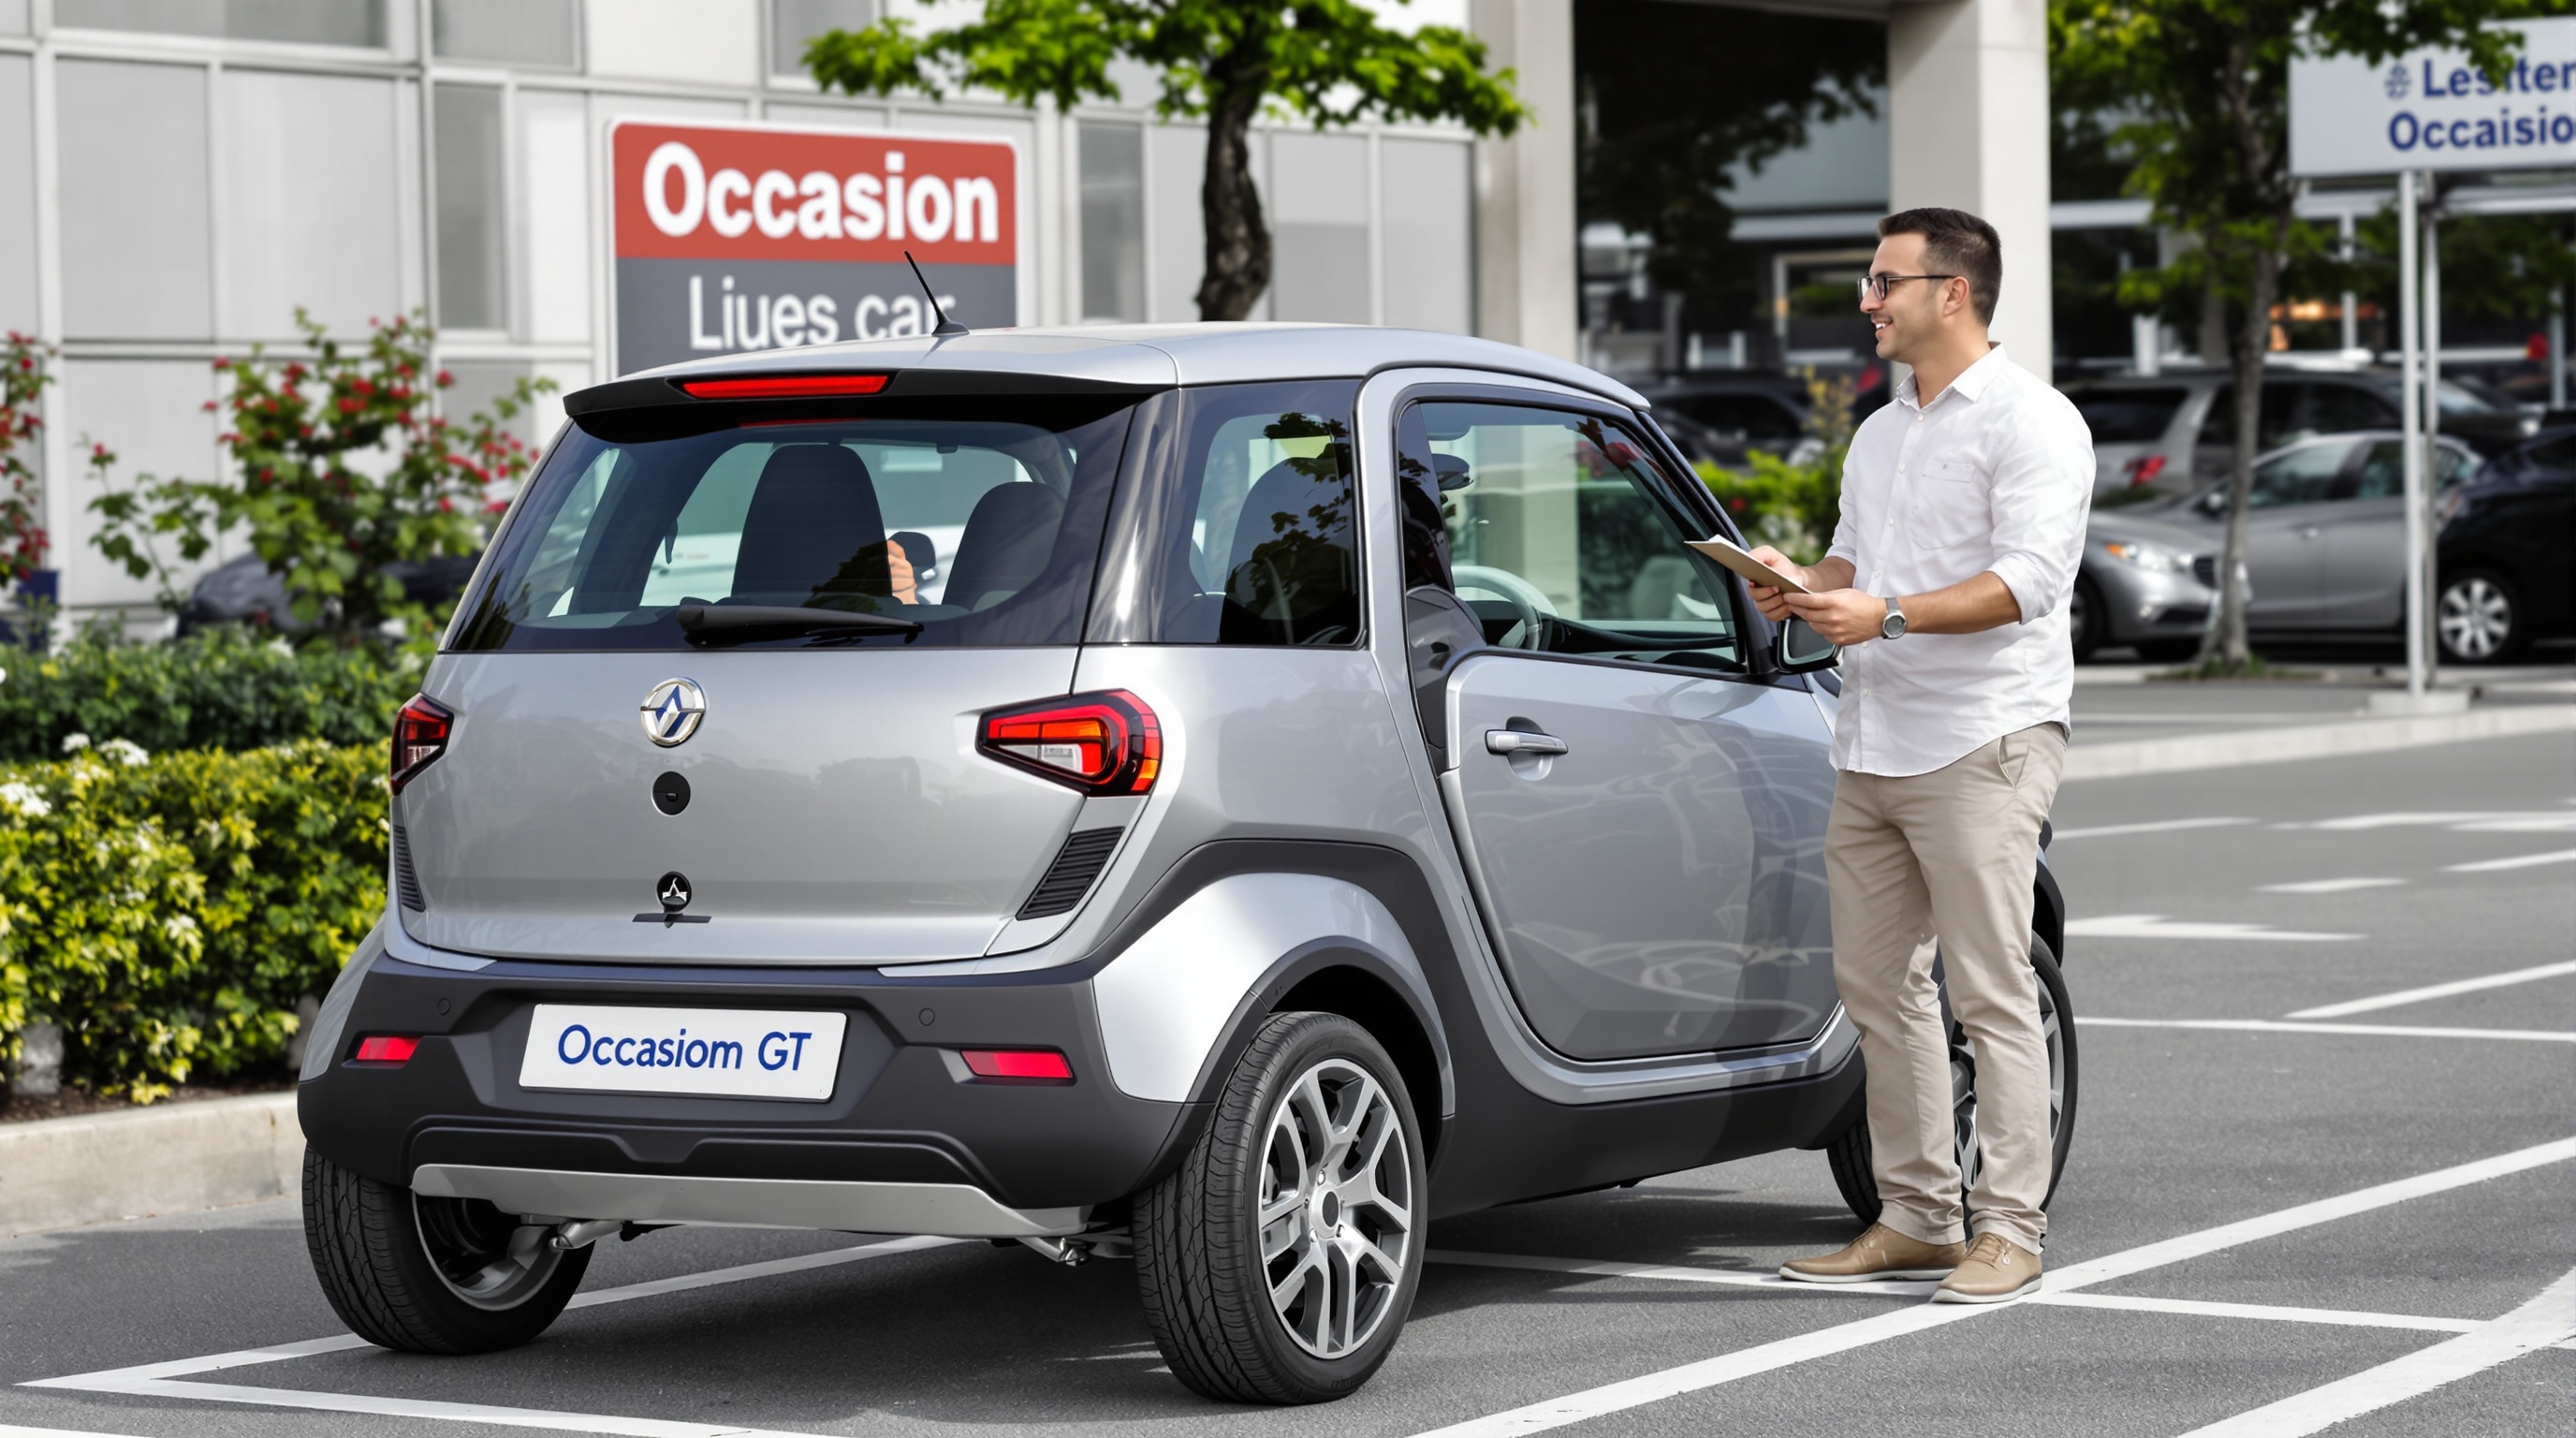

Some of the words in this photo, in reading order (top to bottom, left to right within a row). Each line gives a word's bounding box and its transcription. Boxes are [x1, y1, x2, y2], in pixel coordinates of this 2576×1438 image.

[2389, 106, 2576, 151] Occaisio
[643, 141, 1000, 243] Occasion
[689, 275, 841, 350] Liues
[558, 1024, 743, 1070] Occasiom
[757, 1031, 812, 1071] GT
